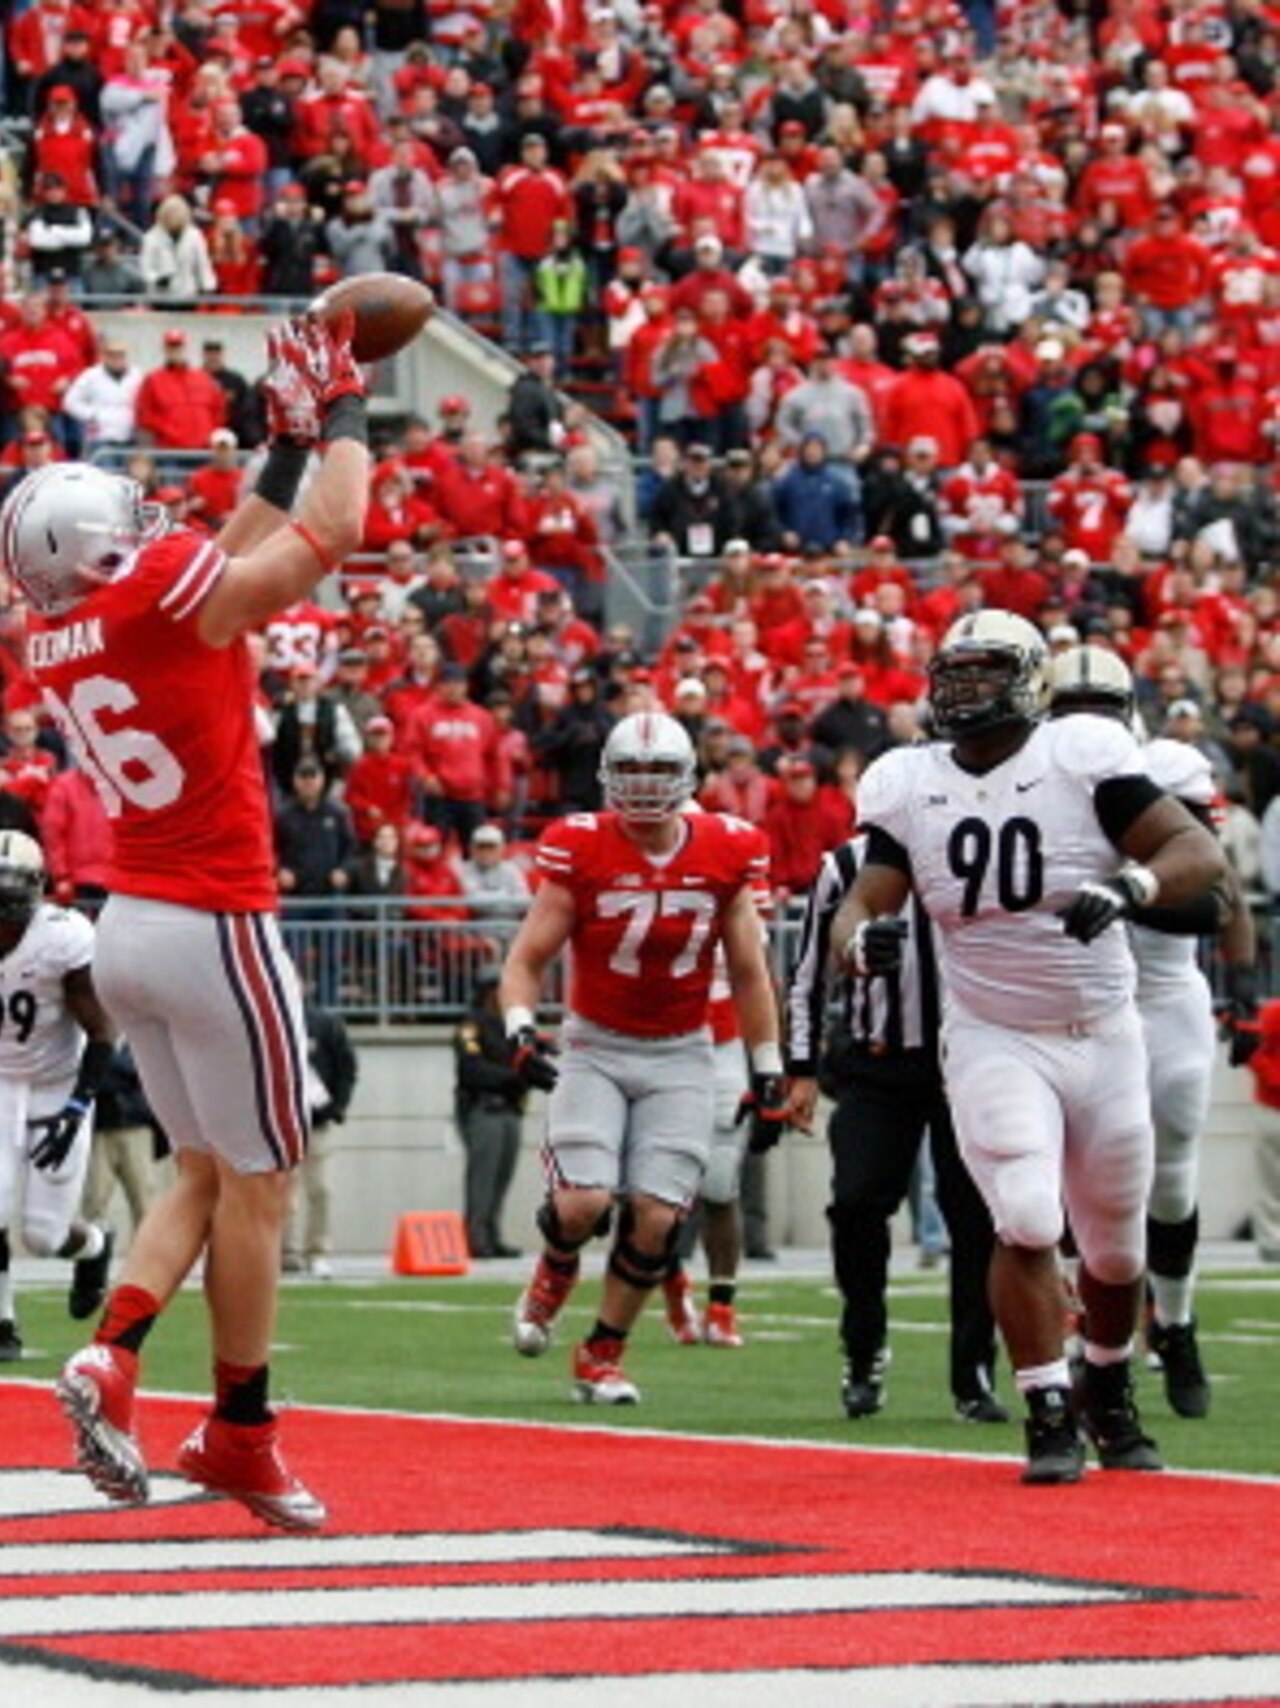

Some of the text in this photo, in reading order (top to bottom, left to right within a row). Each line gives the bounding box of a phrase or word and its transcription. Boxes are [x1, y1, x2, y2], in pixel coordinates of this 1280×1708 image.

[266, 621, 322, 670] 33
[947, 816, 1044, 918] 90
[596, 889, 716, 978] 77
[413, 1220, 460, 1265] 10
